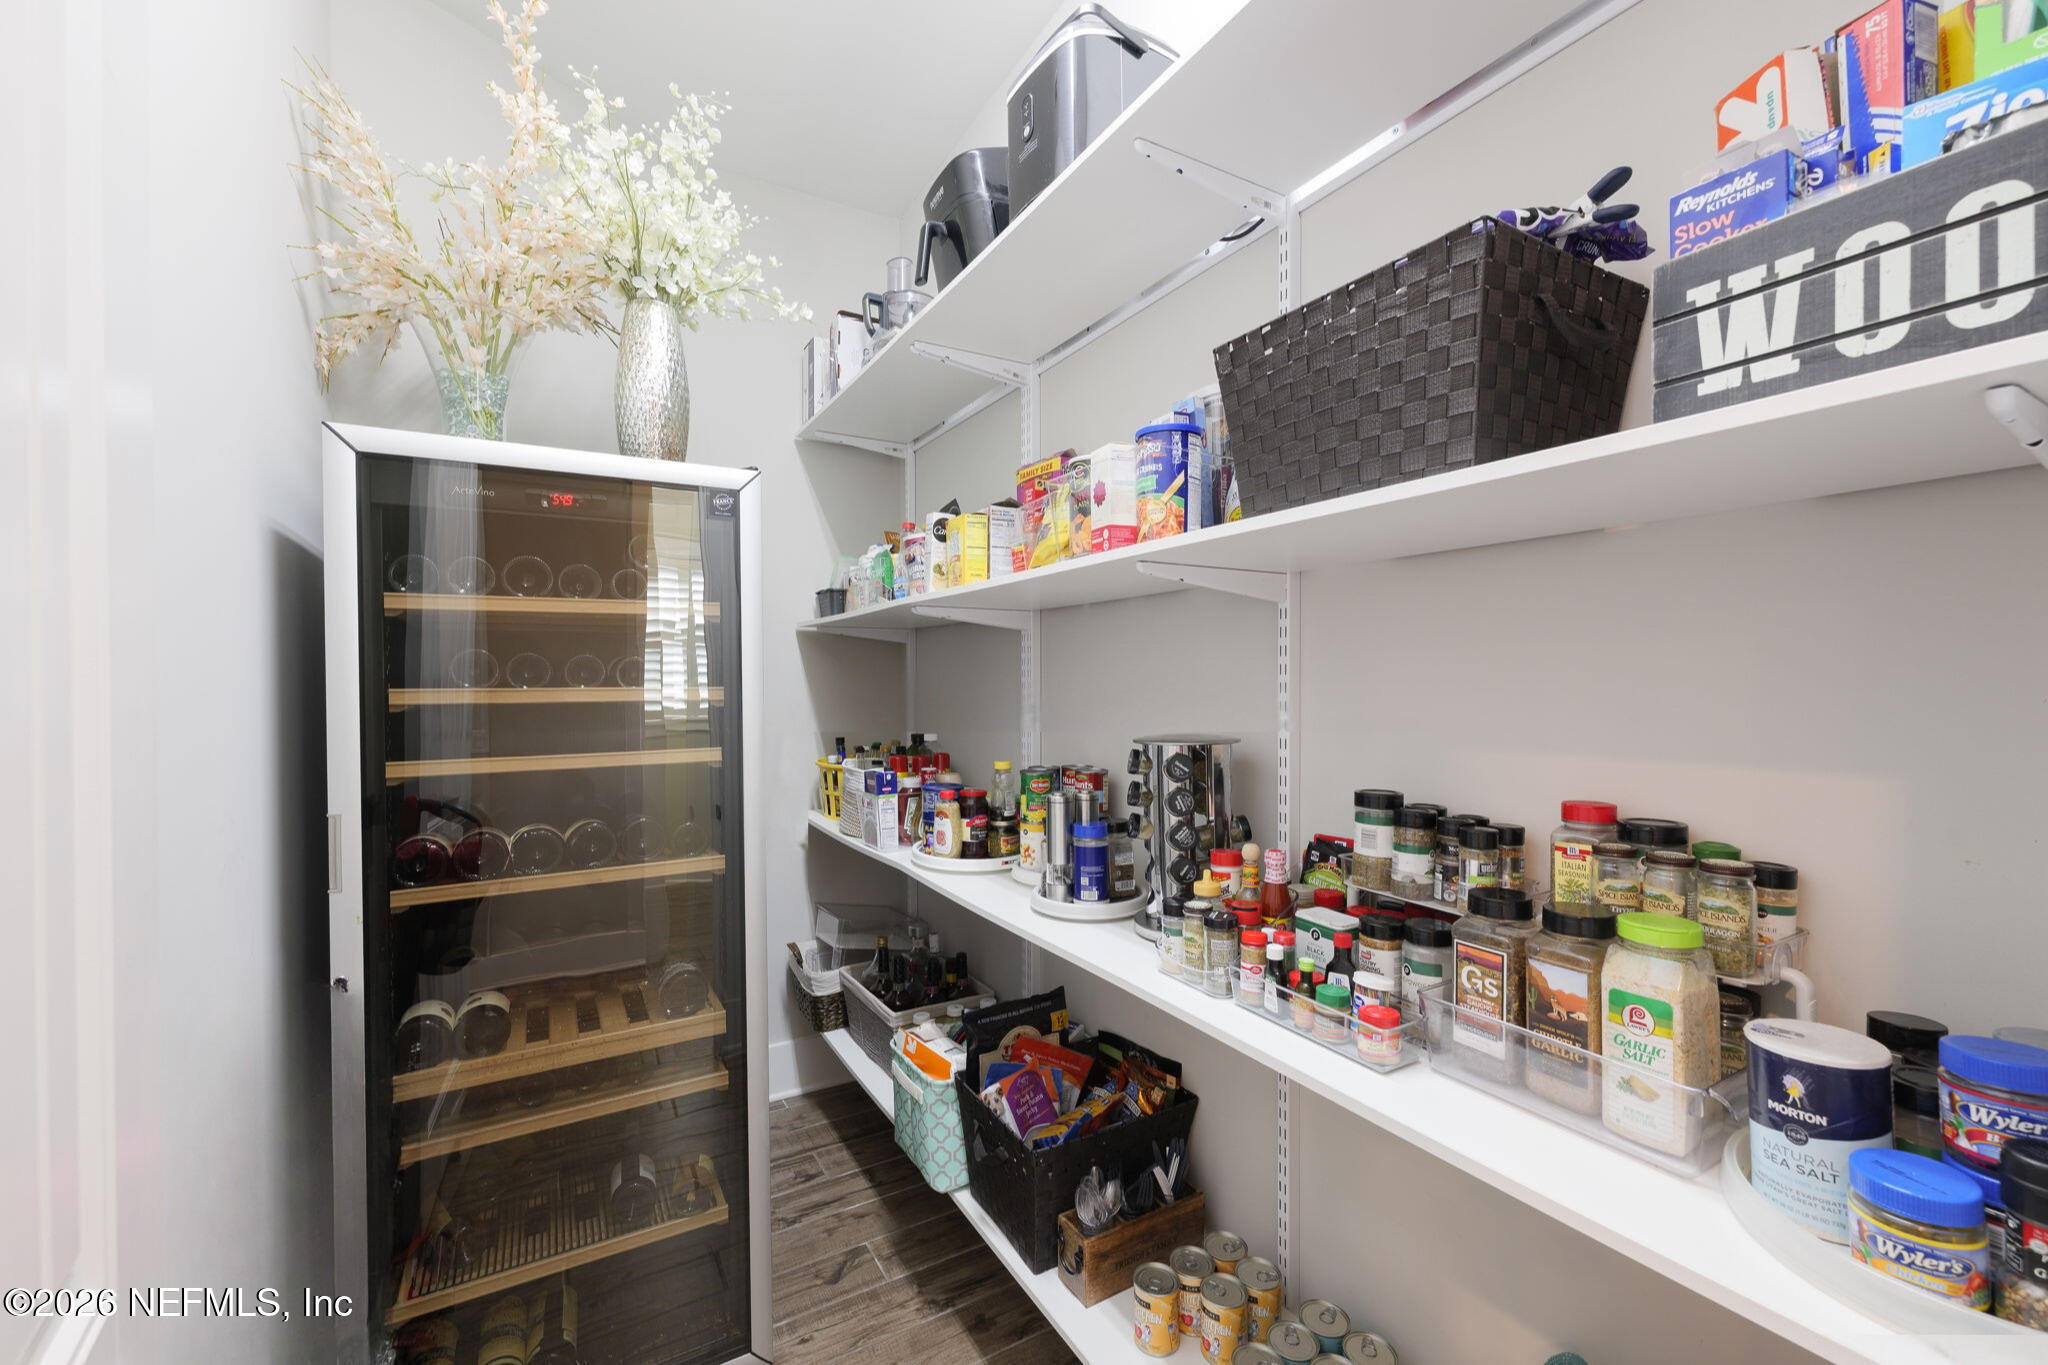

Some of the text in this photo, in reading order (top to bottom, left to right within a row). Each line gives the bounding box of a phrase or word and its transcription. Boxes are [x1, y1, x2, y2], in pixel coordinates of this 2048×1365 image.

[1675, 171, 1758, 217] Reynolds
[1706, 178, 1774, 213] KITCHENS
[1675, 209, 1735, 244] Slow
[1561, 861, 1587, 872] ITALIAN
[1711, 911, 1746, 923] ISLANDS
[1531, 1038, 1584, 1063] GARLIC
[1613, 1033, 1667, 1059] GARLIC
[1623, 1048, 1656, 1066] SALT
[1768, 1098, 1828, 1127] MORTON
[1763, 1136, 1840, 1173] NATURAL
[1763, 1149, 1840, 1184] SEA SALT
[1874, 1234, 1965, 1275] Wyler's
